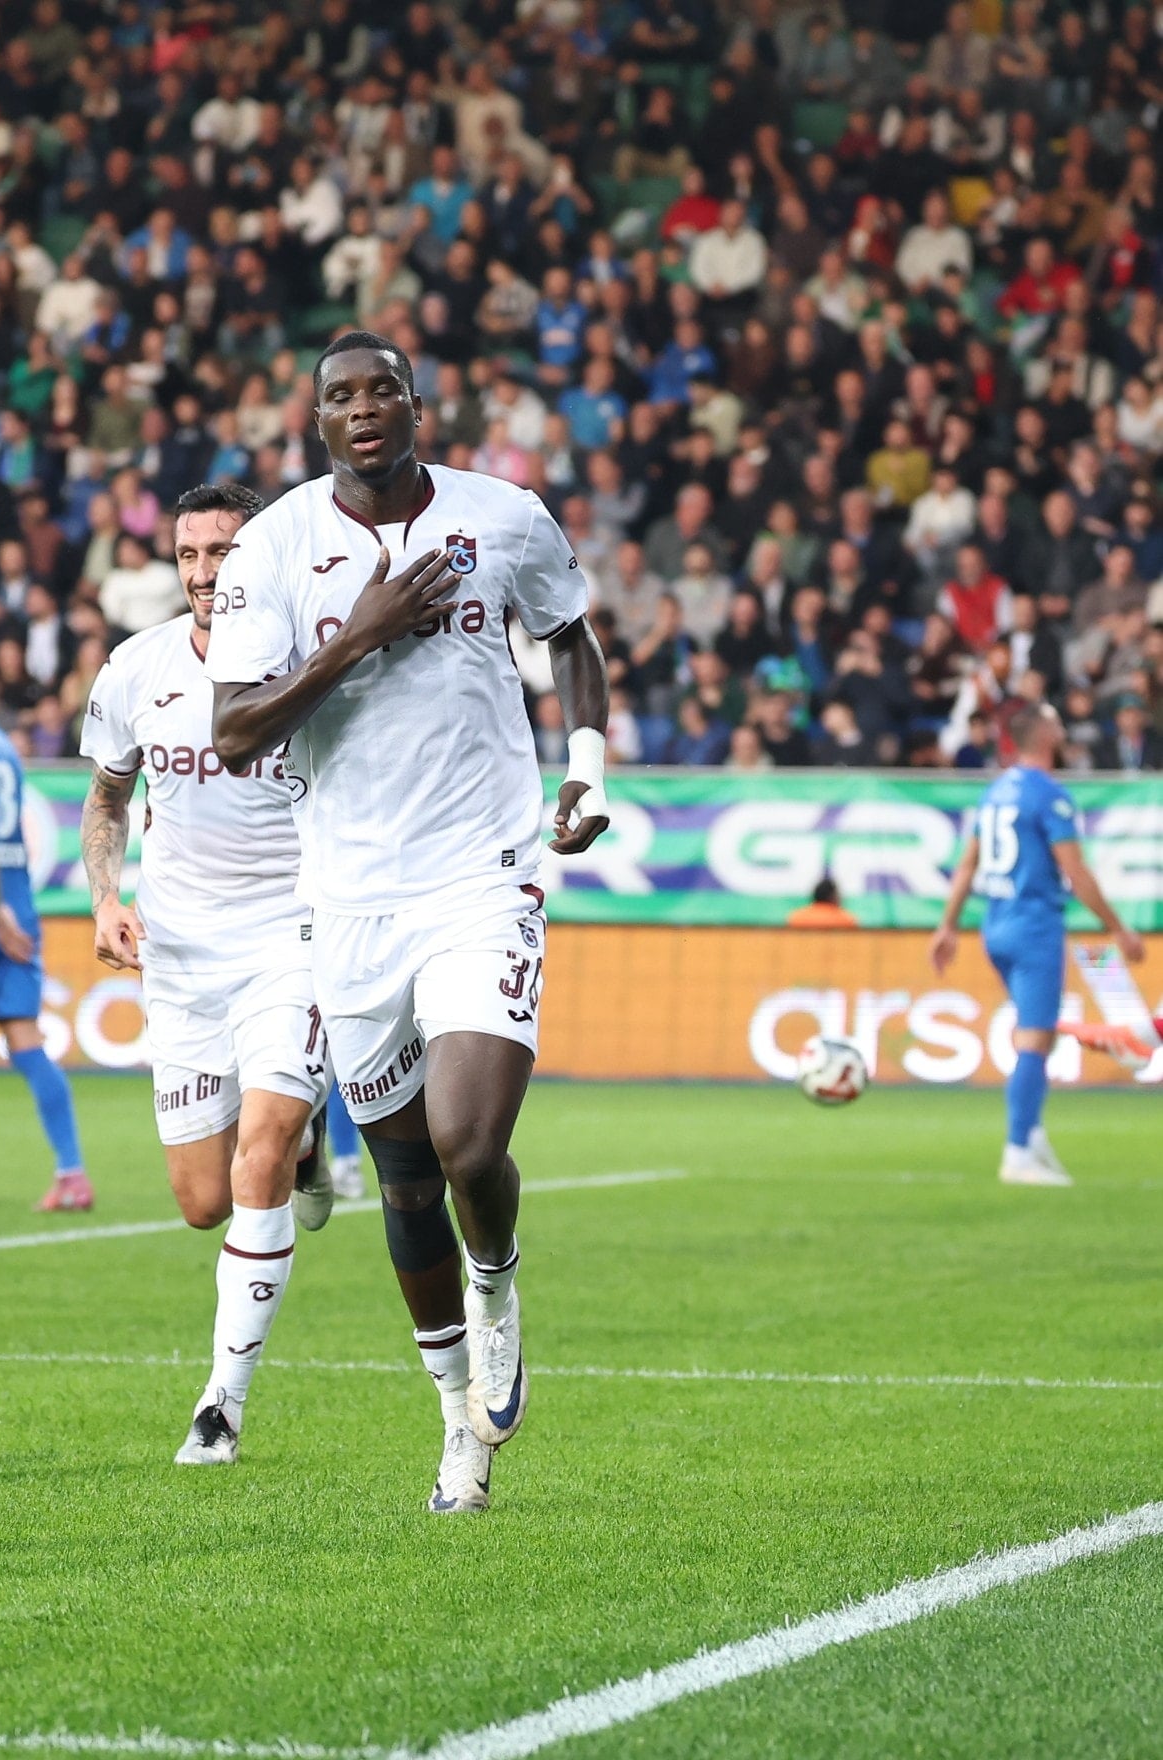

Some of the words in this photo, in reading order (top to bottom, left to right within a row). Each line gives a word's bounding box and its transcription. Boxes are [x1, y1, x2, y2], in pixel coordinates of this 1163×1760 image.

[212, 586, 247, 615] QB
[978, 804, 1020, 875] 15
[196, 1073, 222, 1102] Go
[348, 1063, 400, 1105] Rent
[399, 1037, 423, 1076] Go
